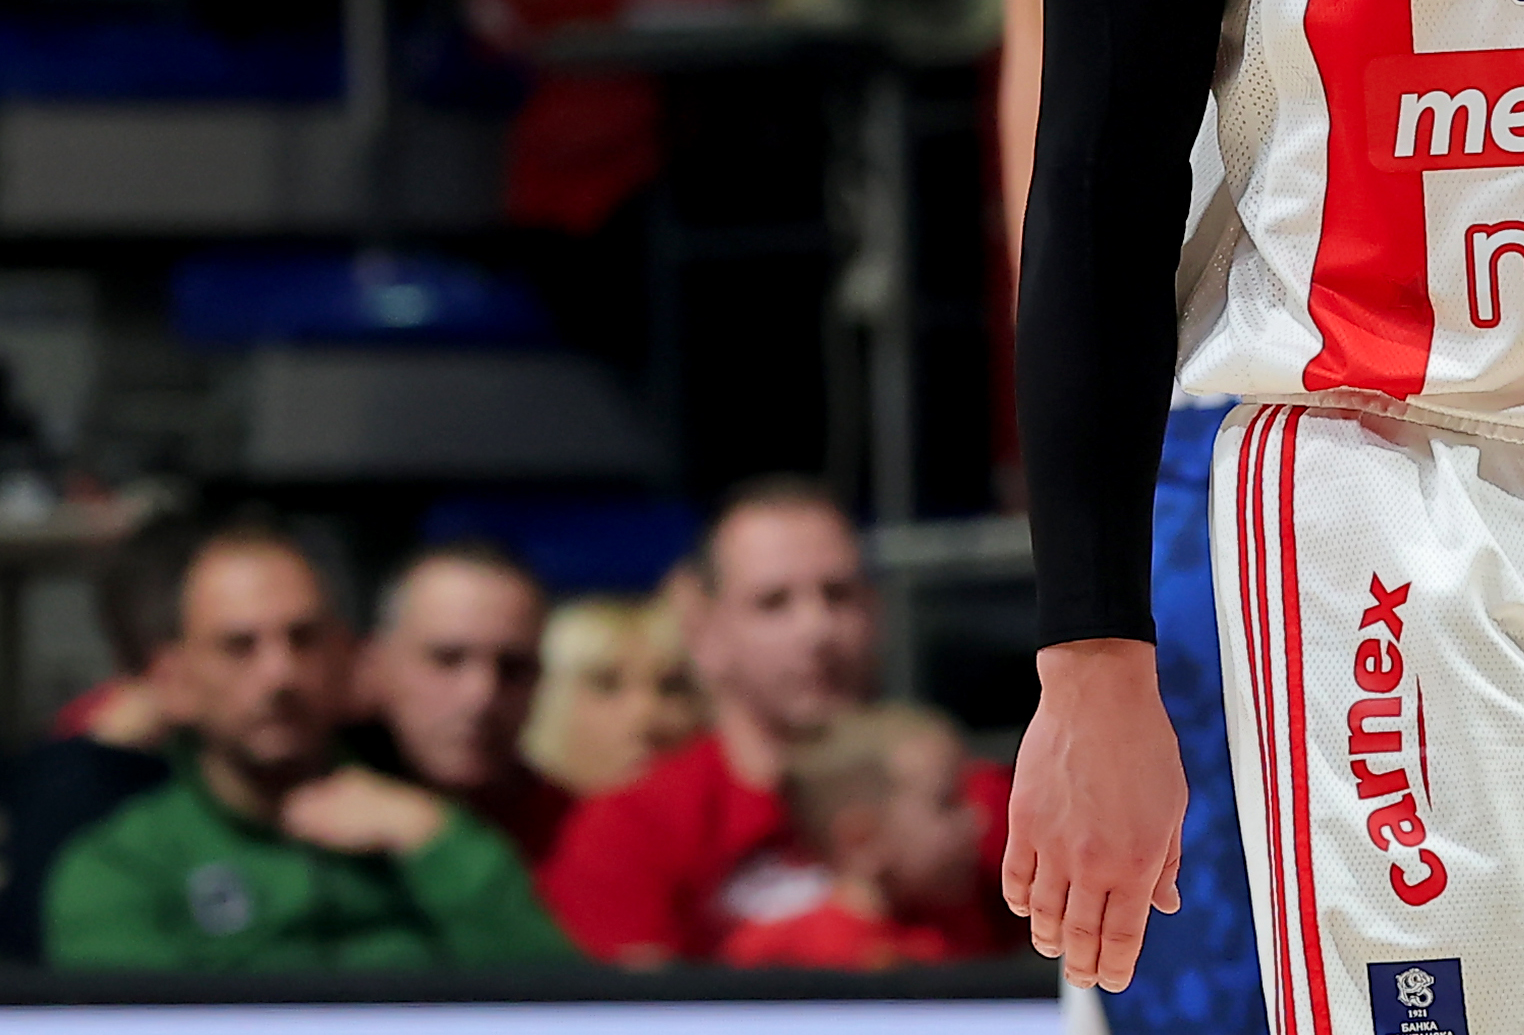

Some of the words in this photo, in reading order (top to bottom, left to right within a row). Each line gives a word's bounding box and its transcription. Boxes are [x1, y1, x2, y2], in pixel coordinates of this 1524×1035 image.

[1346, 569, 1449, 907] carnex
[1408, 1009, 1427, 1018] 1921
[1401, 1021, 1438, 1032] БАНКА
